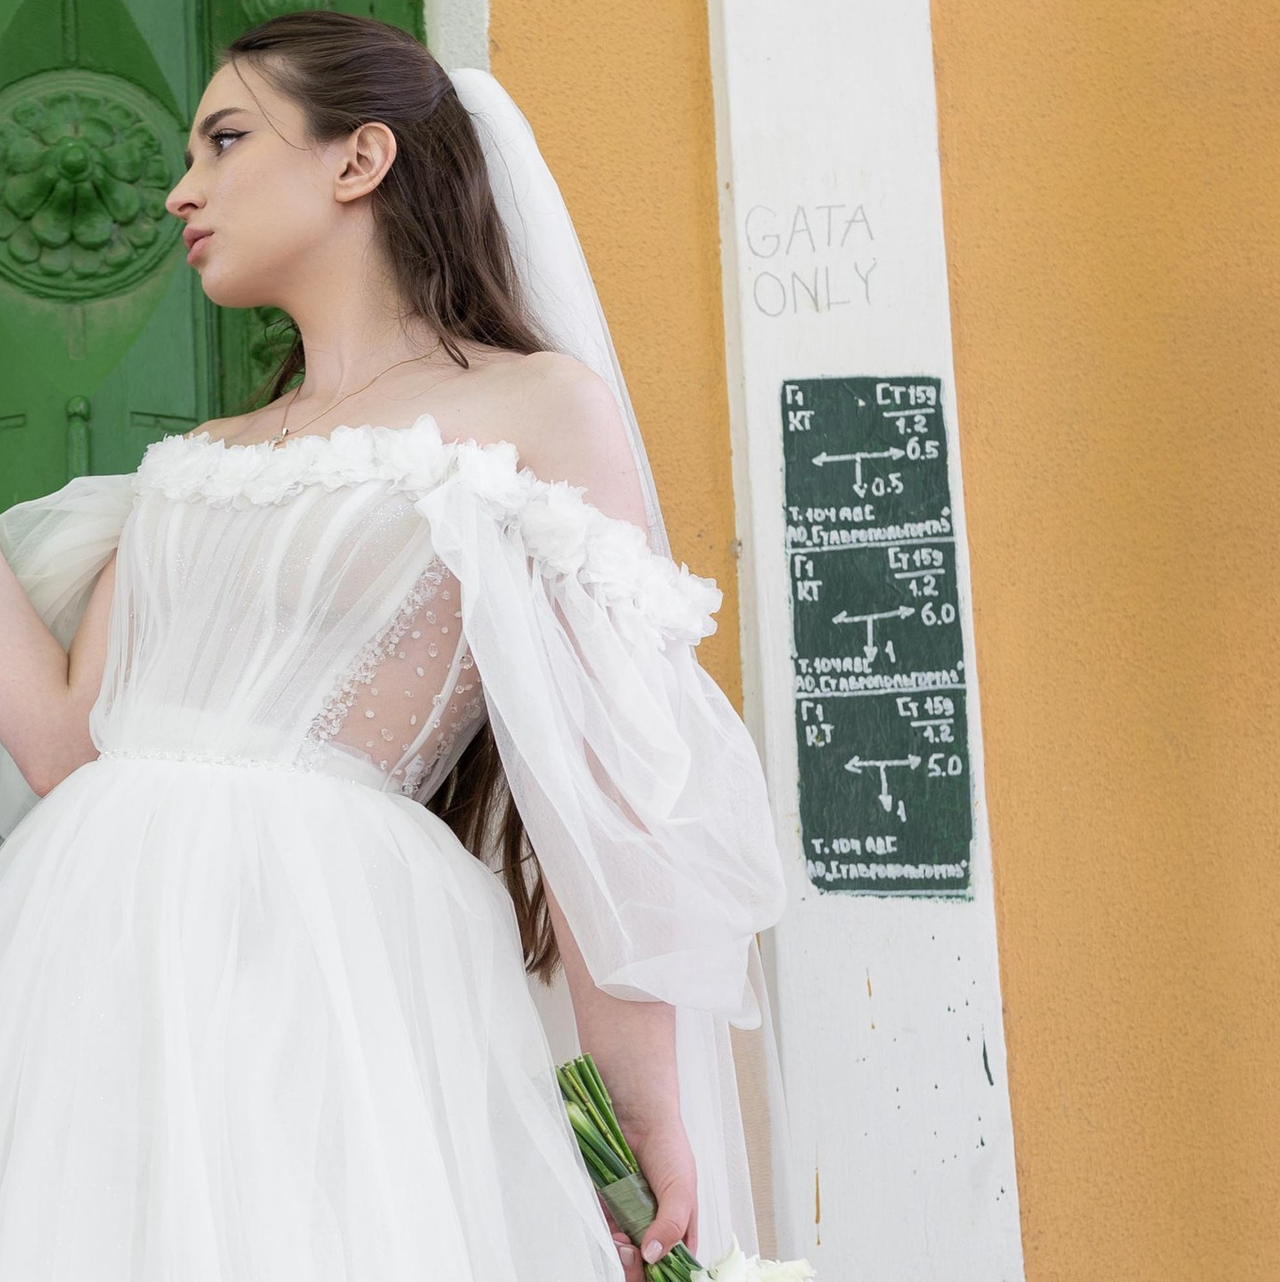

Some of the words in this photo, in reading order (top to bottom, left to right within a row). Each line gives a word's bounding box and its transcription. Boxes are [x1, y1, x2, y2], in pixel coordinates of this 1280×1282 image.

[745, 204, 874, 258] GATA
[753, 257, 876, 317] ONLY
[895, 415, 928, 435] 1.2
[871, 472, 904, 497] 0.5
[909, 575, 939, 598] 1.2
[921, 602, 956, 626] 6.0
[885, 640, 896, 663] 1
[923, 725, 955, 744] 1.2
[928, 753, 963, 778] 5.0
[897, 800, 907, 823] 1
